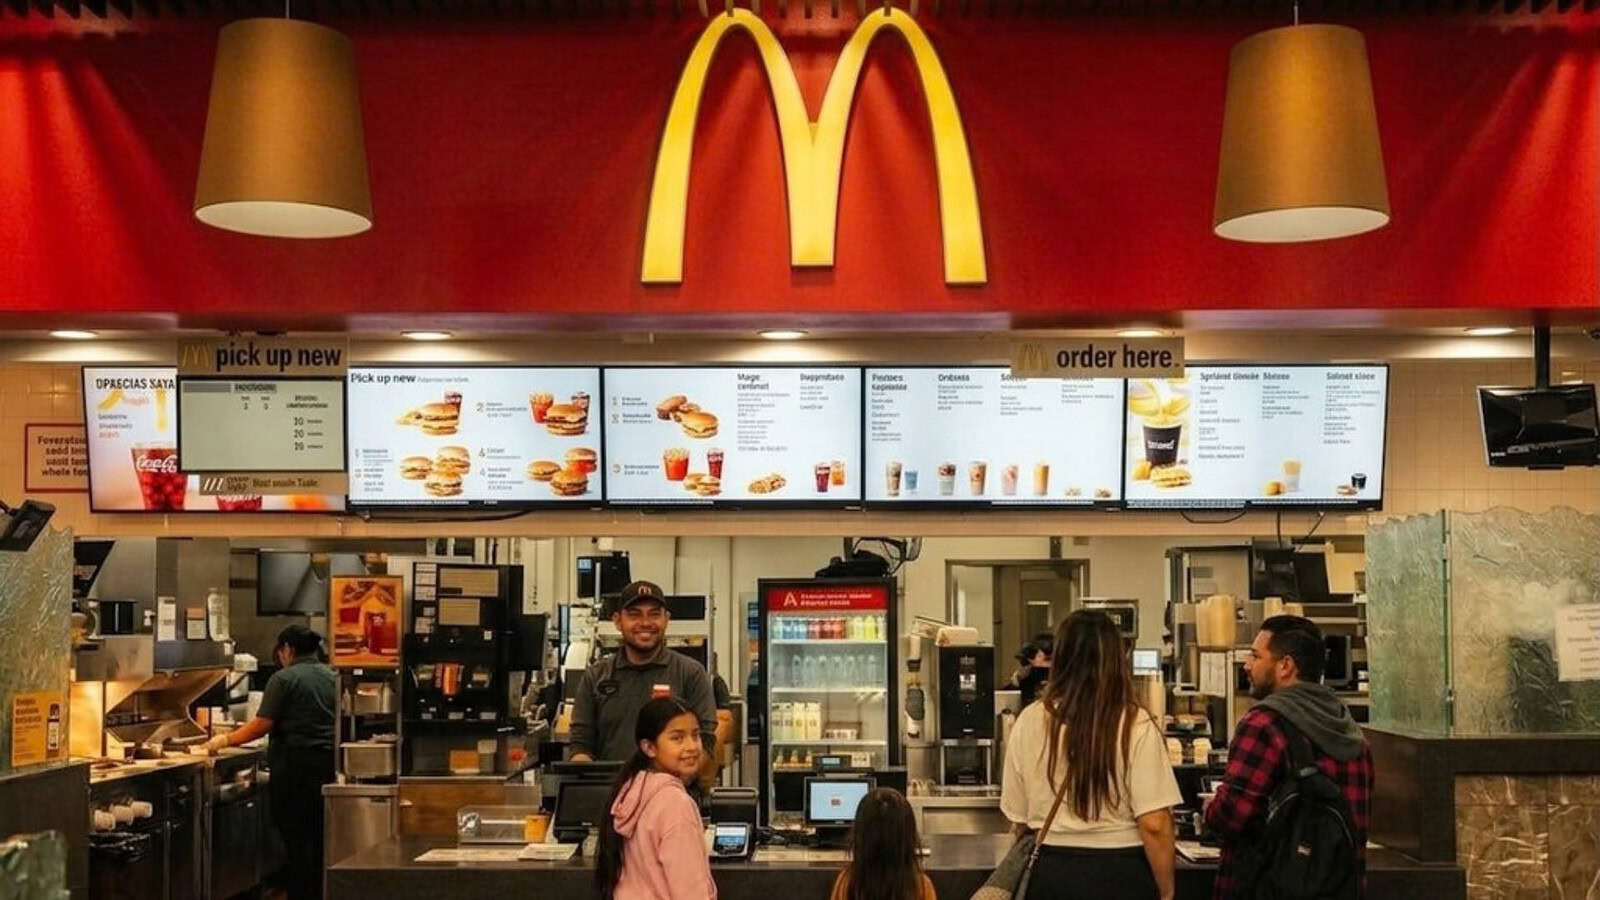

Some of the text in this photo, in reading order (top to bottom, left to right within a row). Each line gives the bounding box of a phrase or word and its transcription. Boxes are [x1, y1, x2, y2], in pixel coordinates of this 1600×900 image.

[216, 341, 260, 372] pick
[266, 348, 292, 372] up
[298, 348, 341, 366] new
[1057, 344, 1117, 368] order
[350, 373, 374, 383] Pick
[377, 376, 391, 384] up
[393, 375, 416, 383] new
